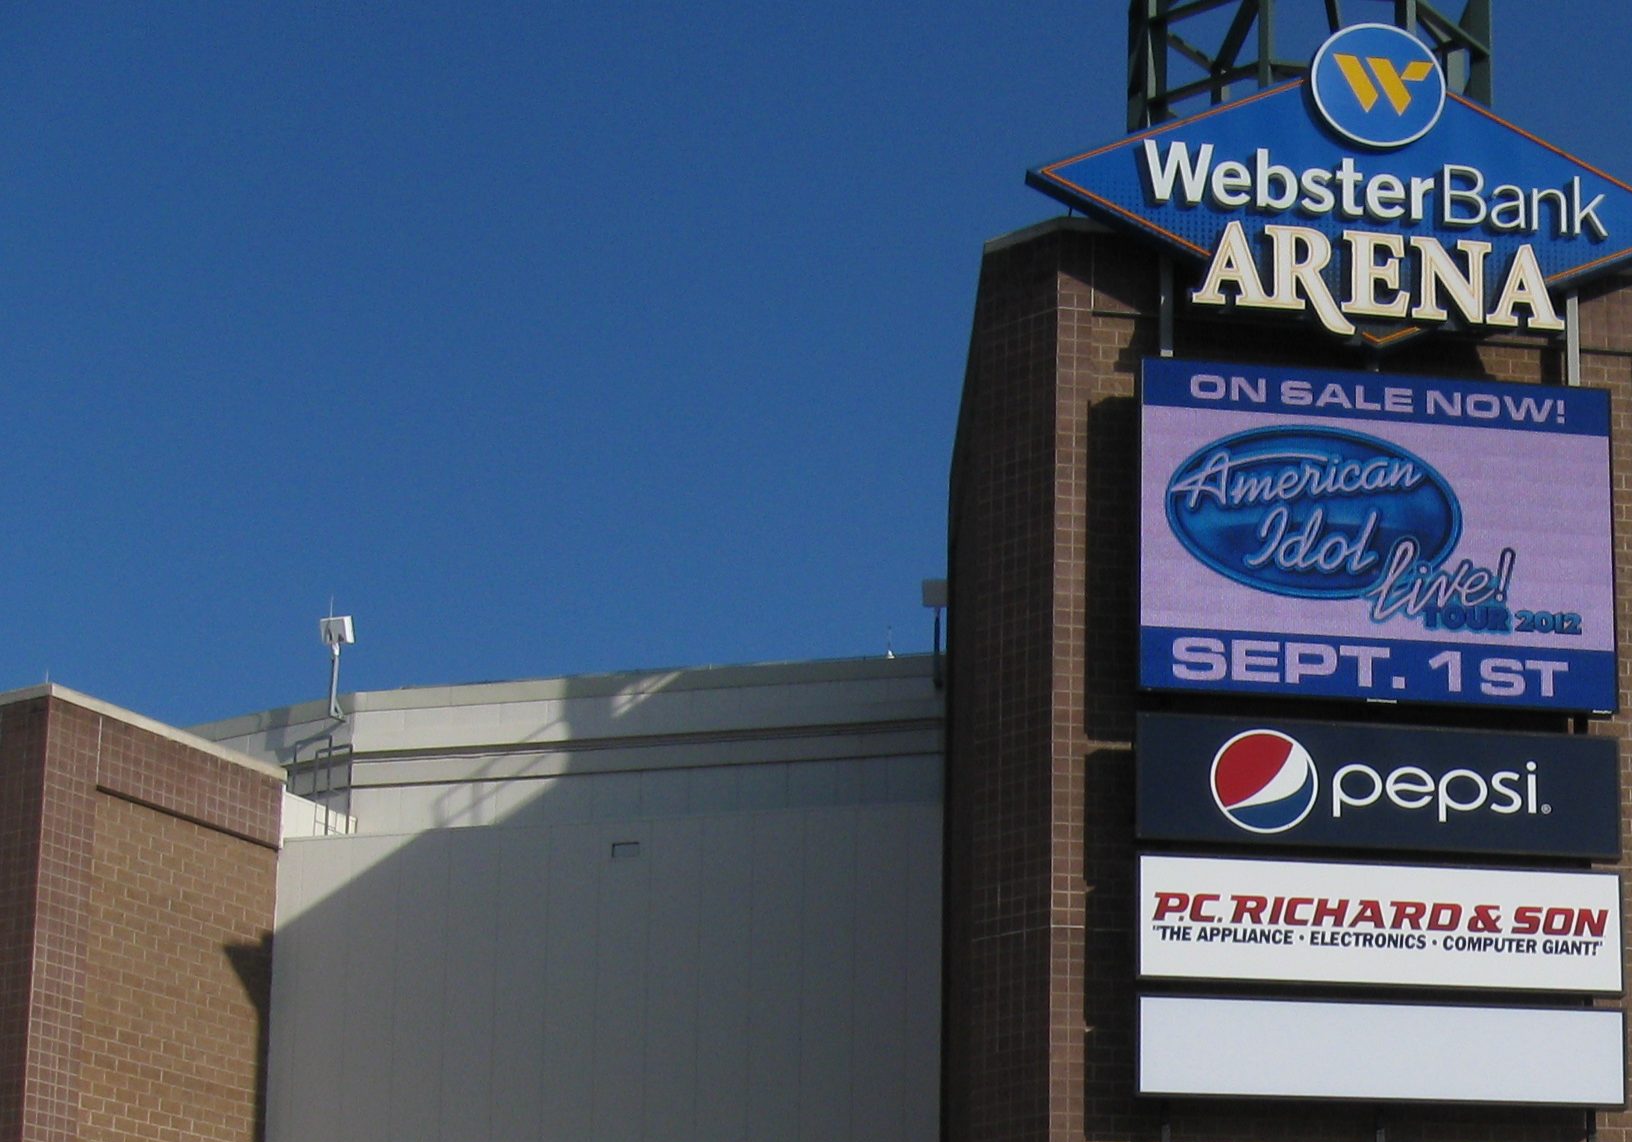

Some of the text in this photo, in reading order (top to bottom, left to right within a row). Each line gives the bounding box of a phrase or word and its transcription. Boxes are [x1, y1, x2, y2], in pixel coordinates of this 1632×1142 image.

[1191, 219, 1565, 337] ARENA
[1189, 374, 1567, 425] ON SALE NOW!
[1170, 448, 1426, 509] American
[1244, 507, 1380, 573] Idol
[1423, 604, 1583, 635] TOUR 2012
[1171, 637, 1569, 698] SEPT. 1ST
[1152, 891, 1609, 938] P.C. RICHARD & SON
[1196, 927, 1294, 945] APPLIANCE
[1309, 931, 1427, 950] ELECTRONICS
[1442, 935, 1537, 954] COMPUTER
